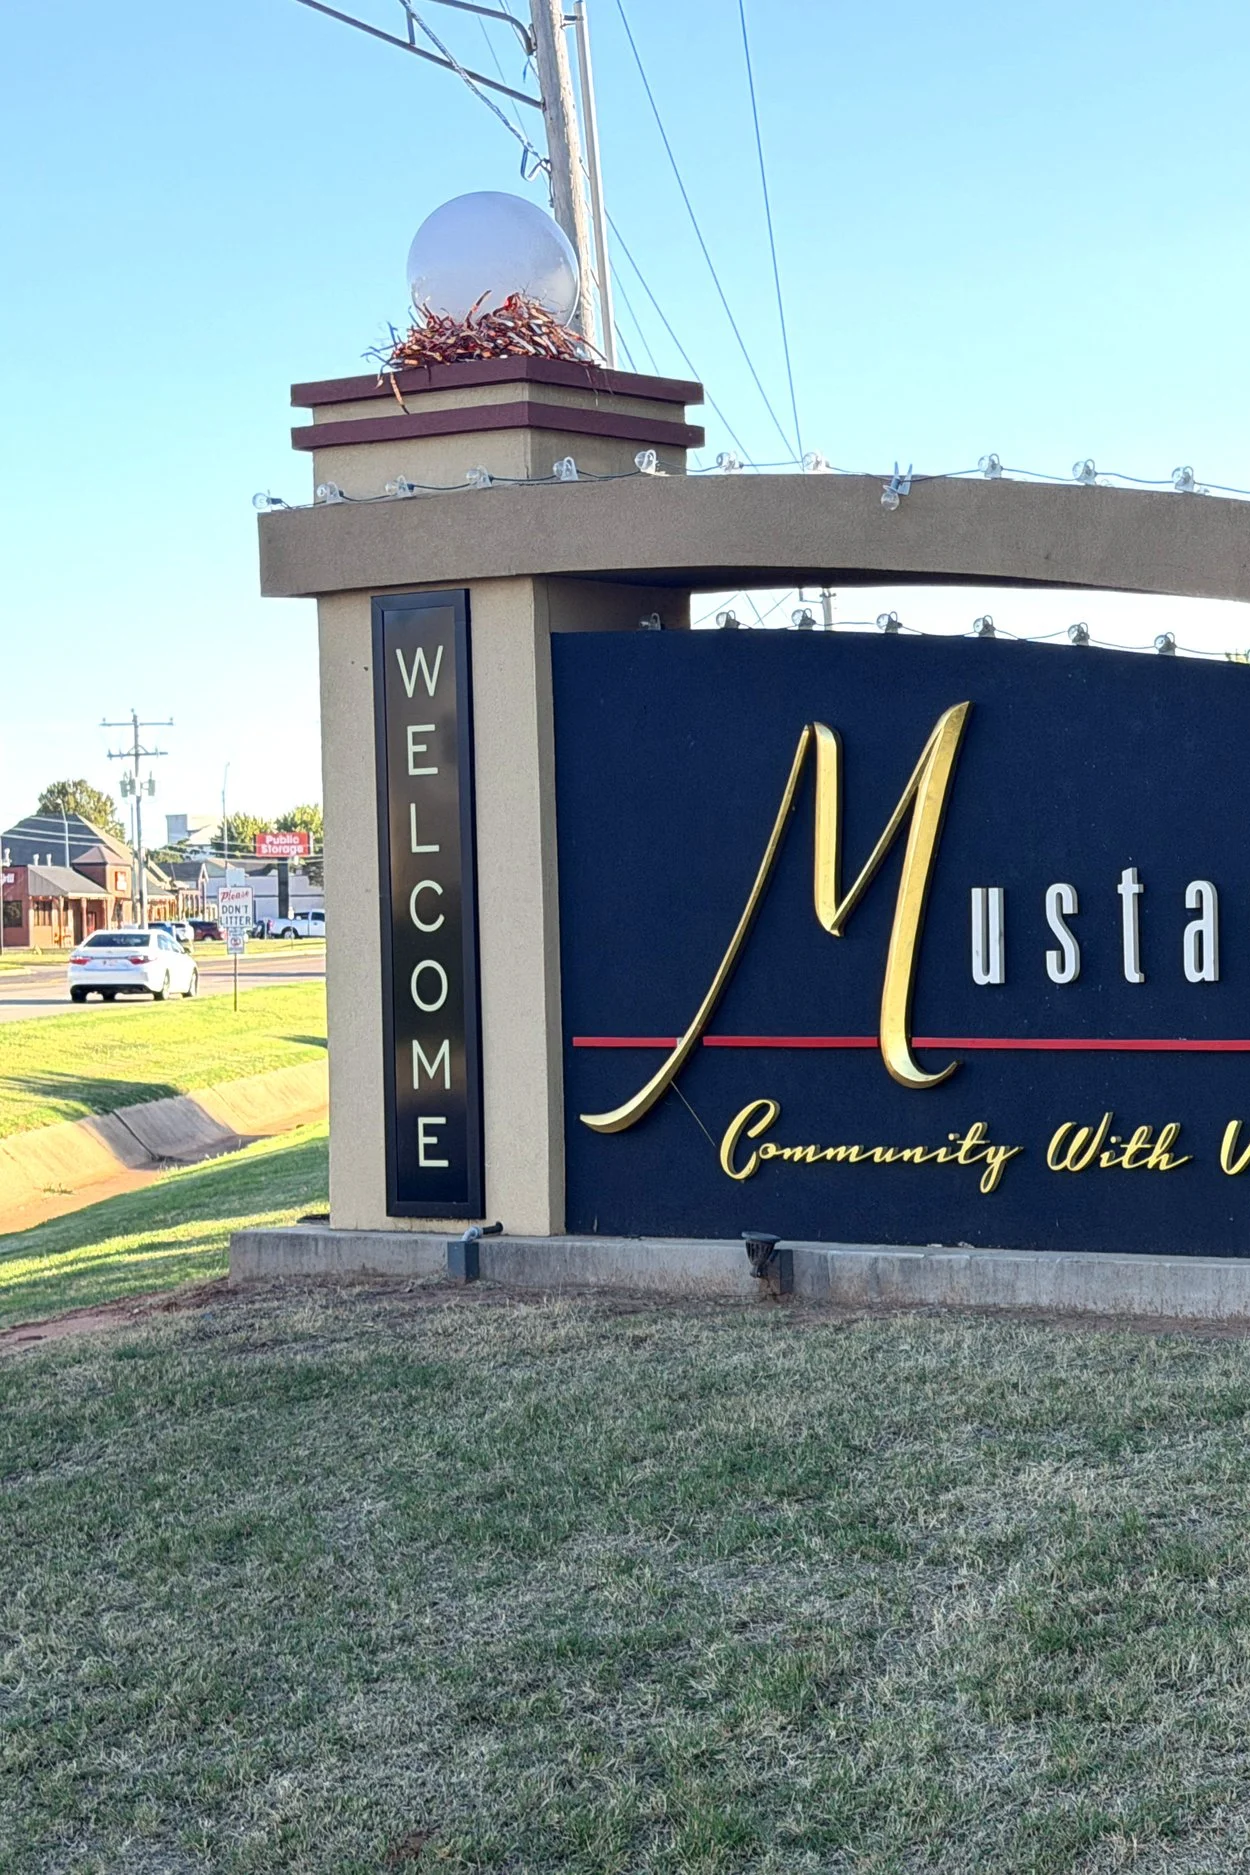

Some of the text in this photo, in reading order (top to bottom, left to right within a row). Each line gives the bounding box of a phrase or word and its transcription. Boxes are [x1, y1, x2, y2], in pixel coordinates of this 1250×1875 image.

[265, 834, 300, 845] Public
[261, 844, 304, 855] Storage
[220, 890, 250, 902] Please
[222, 904, 249, 915] DON'T
[396, 645, 452, 1169] WELCOME
[220, 915, 251, 926] LITTER
[719, 1099, 1024, 1193] Community
[1046, 1111, 1193, 1173] With
